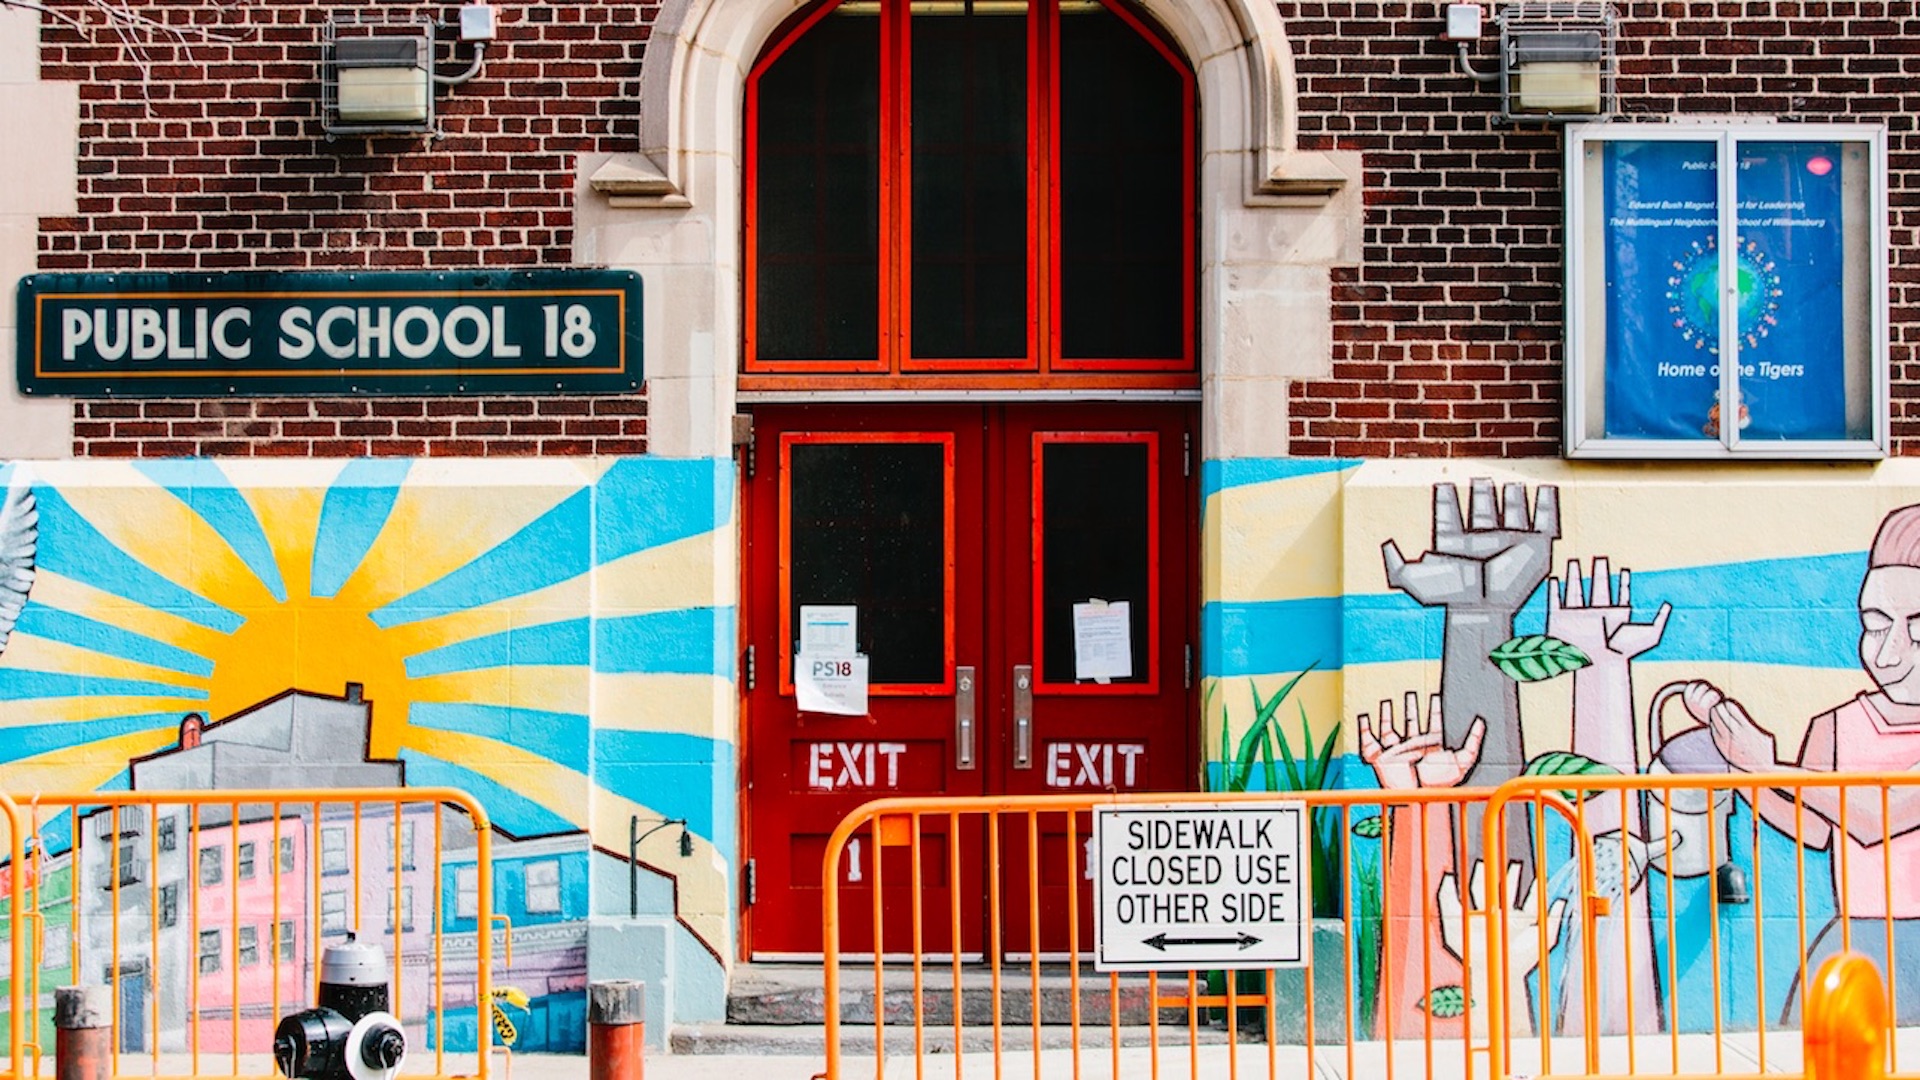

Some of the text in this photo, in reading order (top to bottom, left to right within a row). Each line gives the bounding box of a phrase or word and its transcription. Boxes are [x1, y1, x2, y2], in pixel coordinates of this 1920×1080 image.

[1682, 161, 1708, 171] Public
[1628, 201, 1661, 210] Edward
[1662, 200, 1683, 210] Bush
[1684, 201, 1715, 212] Magnet
[1745, 201, 1758, 210] for
[1759, 201, 1806, 212] Leadership
[1609, 218, 1625, 227] The
[1626, 218, 1673, 228] Multilingual
[1736, 218, 1761, 227] chool
[1762, 218, 1773, 227] of
[1773, 218, 1826, 228] Williamsburg
[62, 304, 597, 361] PUBLIC SCHOOL 18
[1658, 362, 1706, 377] Home
[1709, 364, 1720, 377] o
[1759, 362, 1804, 380] Tigers
[813, 661, 852, 677] PS18
[809, 743, 906, 791] EXIT
[1046, 743, 1144, 787] EXIT
[1128, 819, 1273, 850] SIDEWALK
[847, 839, 862, 882] 1
[1112, 854, 1291, 886] CLOSED USE
[1117, 893, 1285, 924] OTHER SIDE
